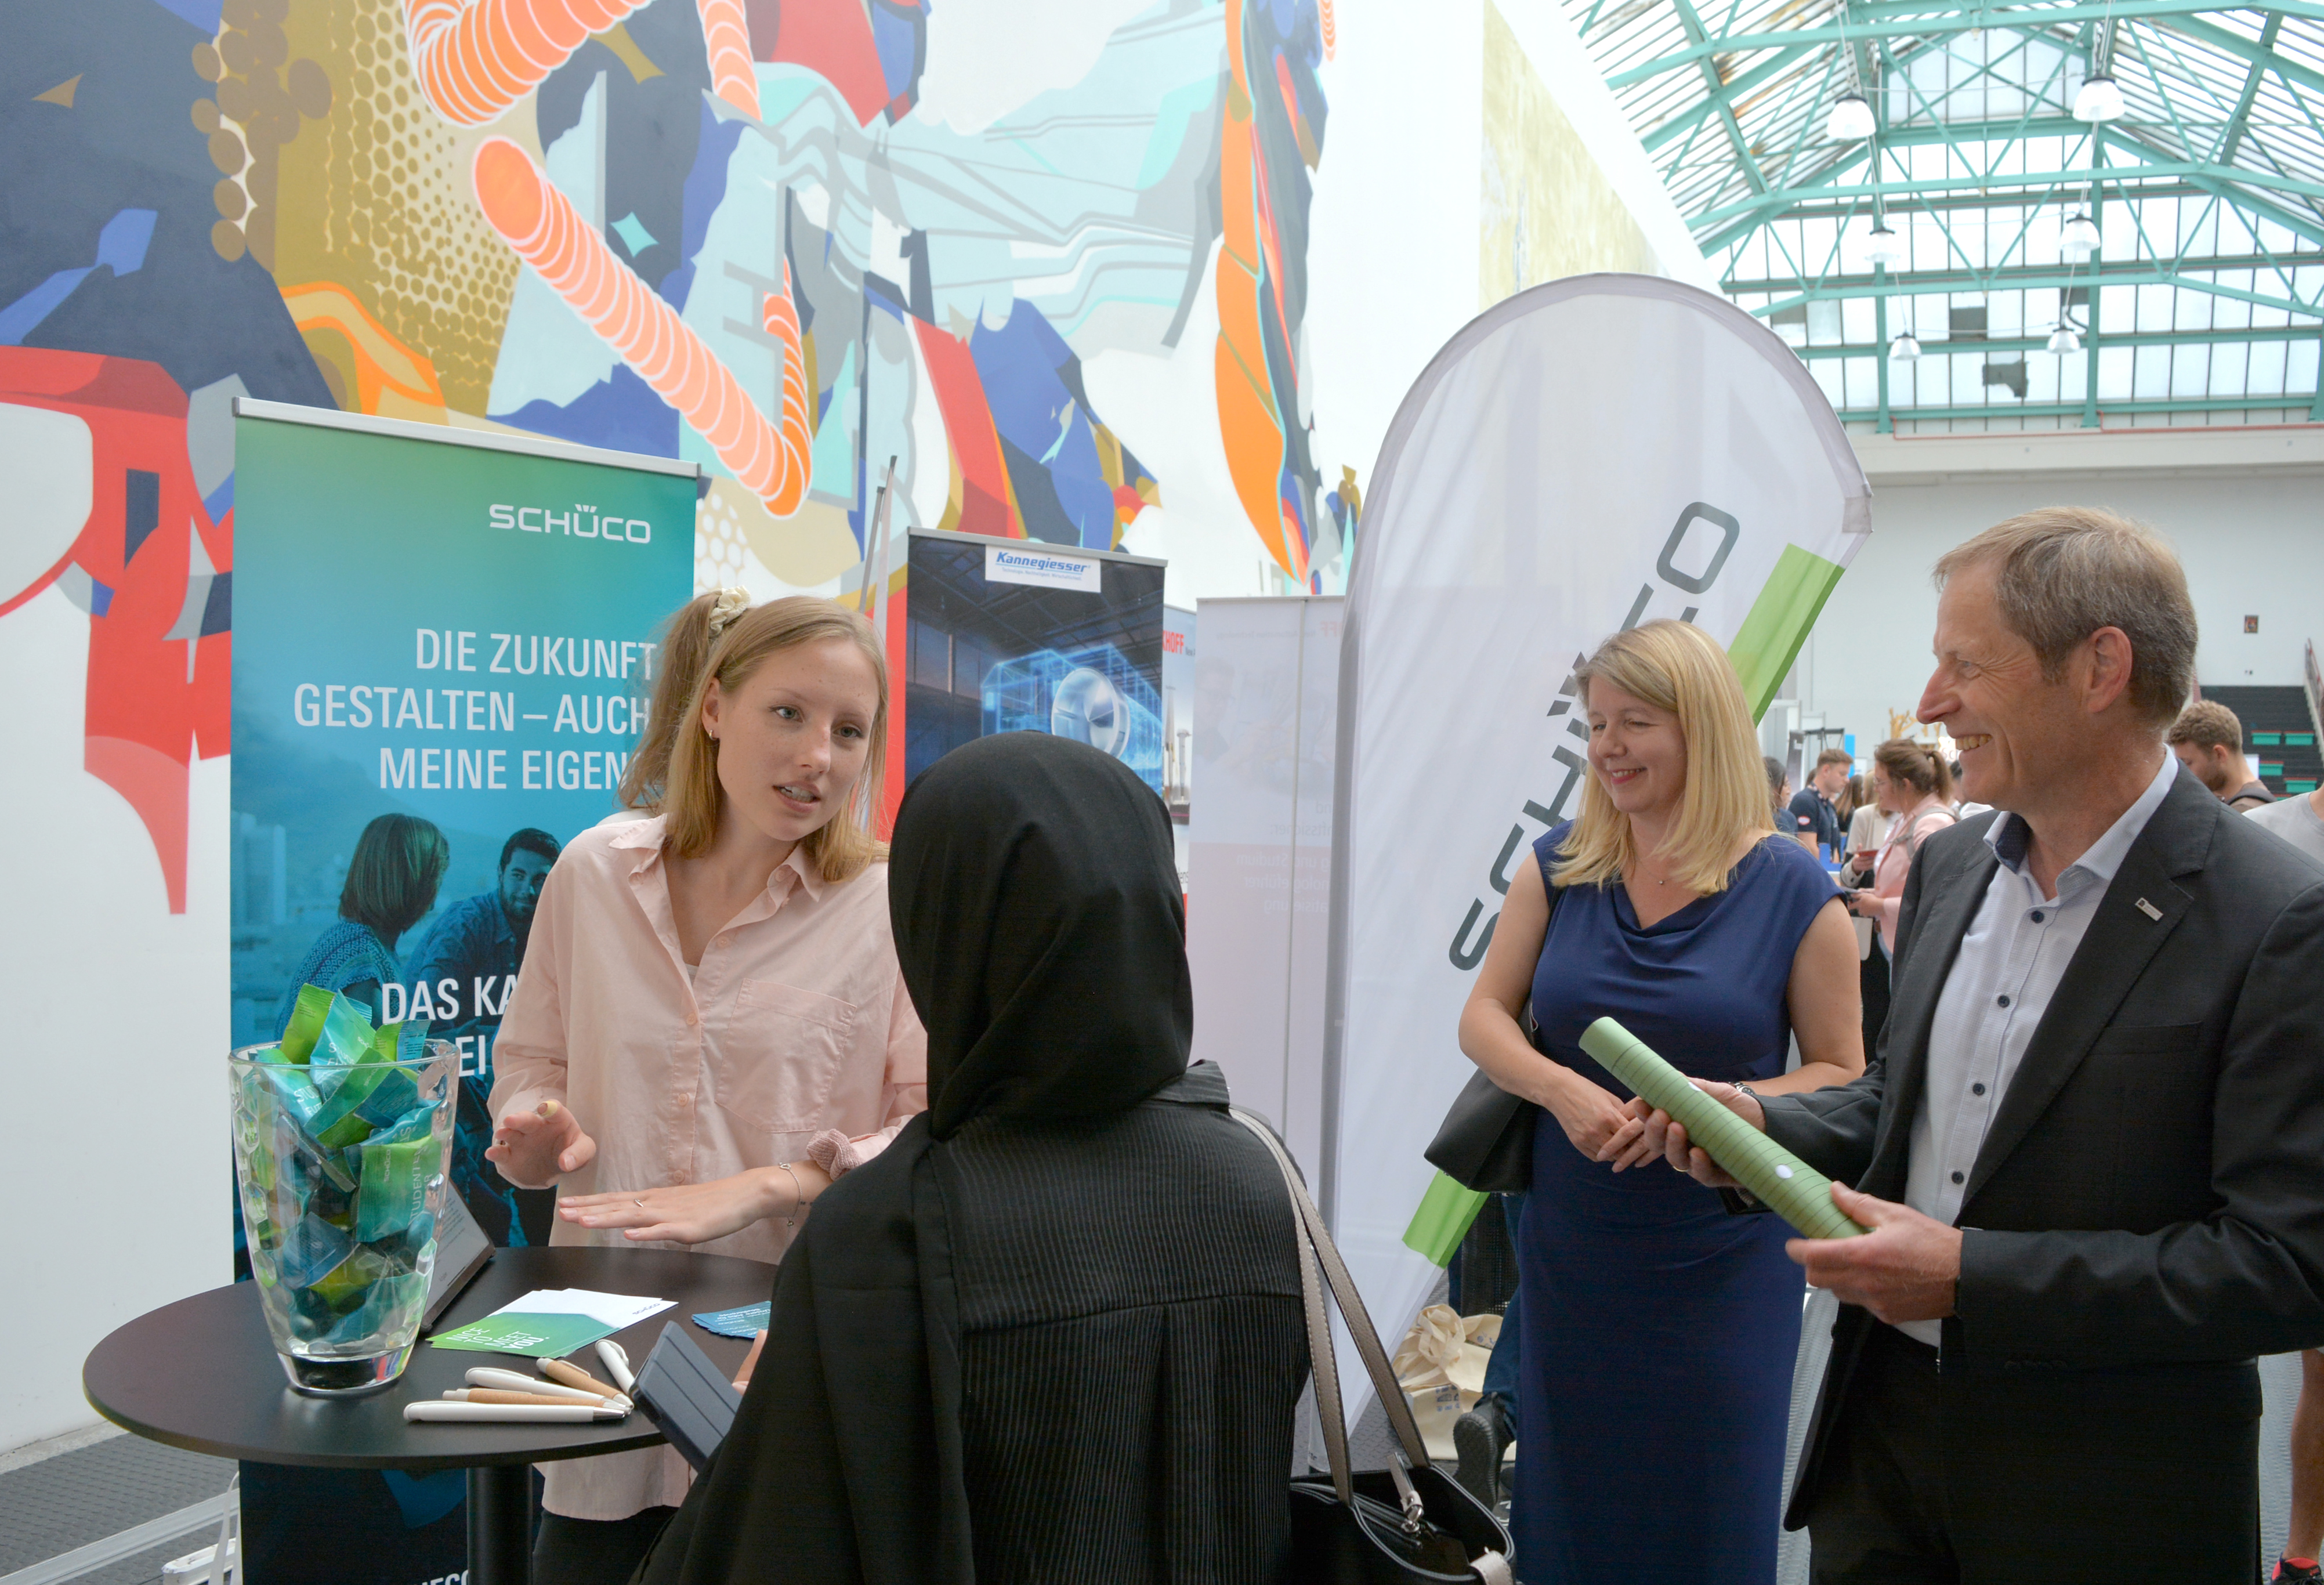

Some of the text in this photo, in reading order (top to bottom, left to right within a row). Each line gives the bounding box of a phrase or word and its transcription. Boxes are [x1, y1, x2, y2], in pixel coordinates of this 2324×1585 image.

[488, 503, 651, 544] SCHÜCO
[996, 551, 1088, 573] Kannegiesser
[416, 627, 657, 681] DIE ZUKUNFT
[294, 683, 515, 732] GESTALTEN
[553, 693, 650, 735] AUCH
[379, 747, 506, 790] MEINE
[381, 978, 460, 1025] DAS
[446, 1327, 490, 1341] NICE
[464, 1336, 493, 1344] TO
[484, 1331, 531, 1347] MEET
[502, 1336, 550, 1349] YOU.
